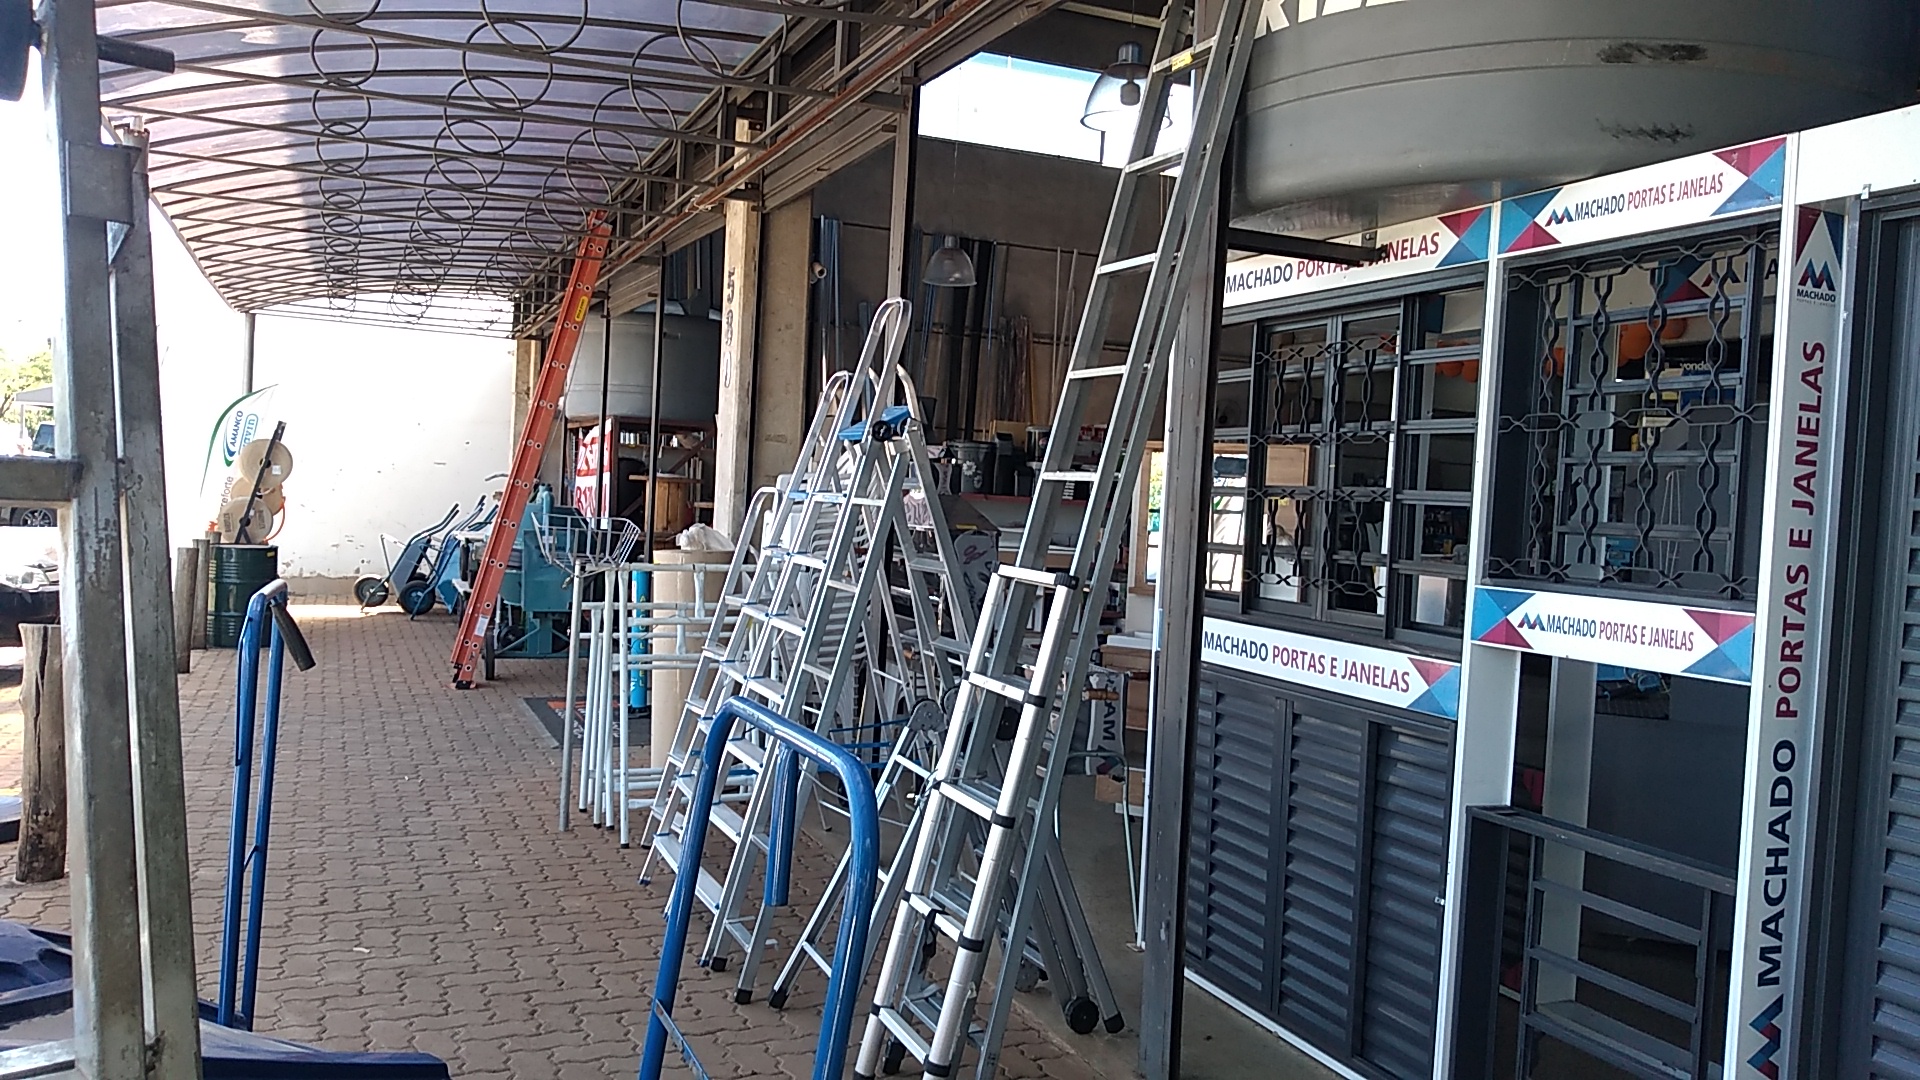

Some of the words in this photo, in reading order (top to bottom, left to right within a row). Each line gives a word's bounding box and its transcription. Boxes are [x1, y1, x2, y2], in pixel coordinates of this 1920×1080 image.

[1574, 193, 1625, 221] MACHADO
[1627, 184, 1666, 211] PORTAS
[1669, 182, 1675, 203] E
[1677, 173, 1724, 202] JANELAS
[1225, 262, 1294, 293] MACHADO
[1369, 231, 1440, 267] NELAS
[1796, 288, 1836, 303] MACHADO
[230, 410, 243, 447] AMANCO
[243, 418, 256, 447] avin
[1791, 341, 1825, 516] JANELAS
[1789, 527, 1813, 549] E
[1546, 613, 1597, 639] MACHADO
[1599, 621, 1638, 644] PORTAS
[1640, 625, 1646, 646] E
[1649, 627, 1694, 652] JANELAS
[1775, 563, 1810, 718] PORTAS
[1203, 631, 1269, 662] MACHADO
[1272, 645, 1325, 675] PORTAS
[1330, 657, 1338, 677] E
[1341, 660, 1410, 693] JANELAS
[1757, 739, 1796, 987] MACHADO
